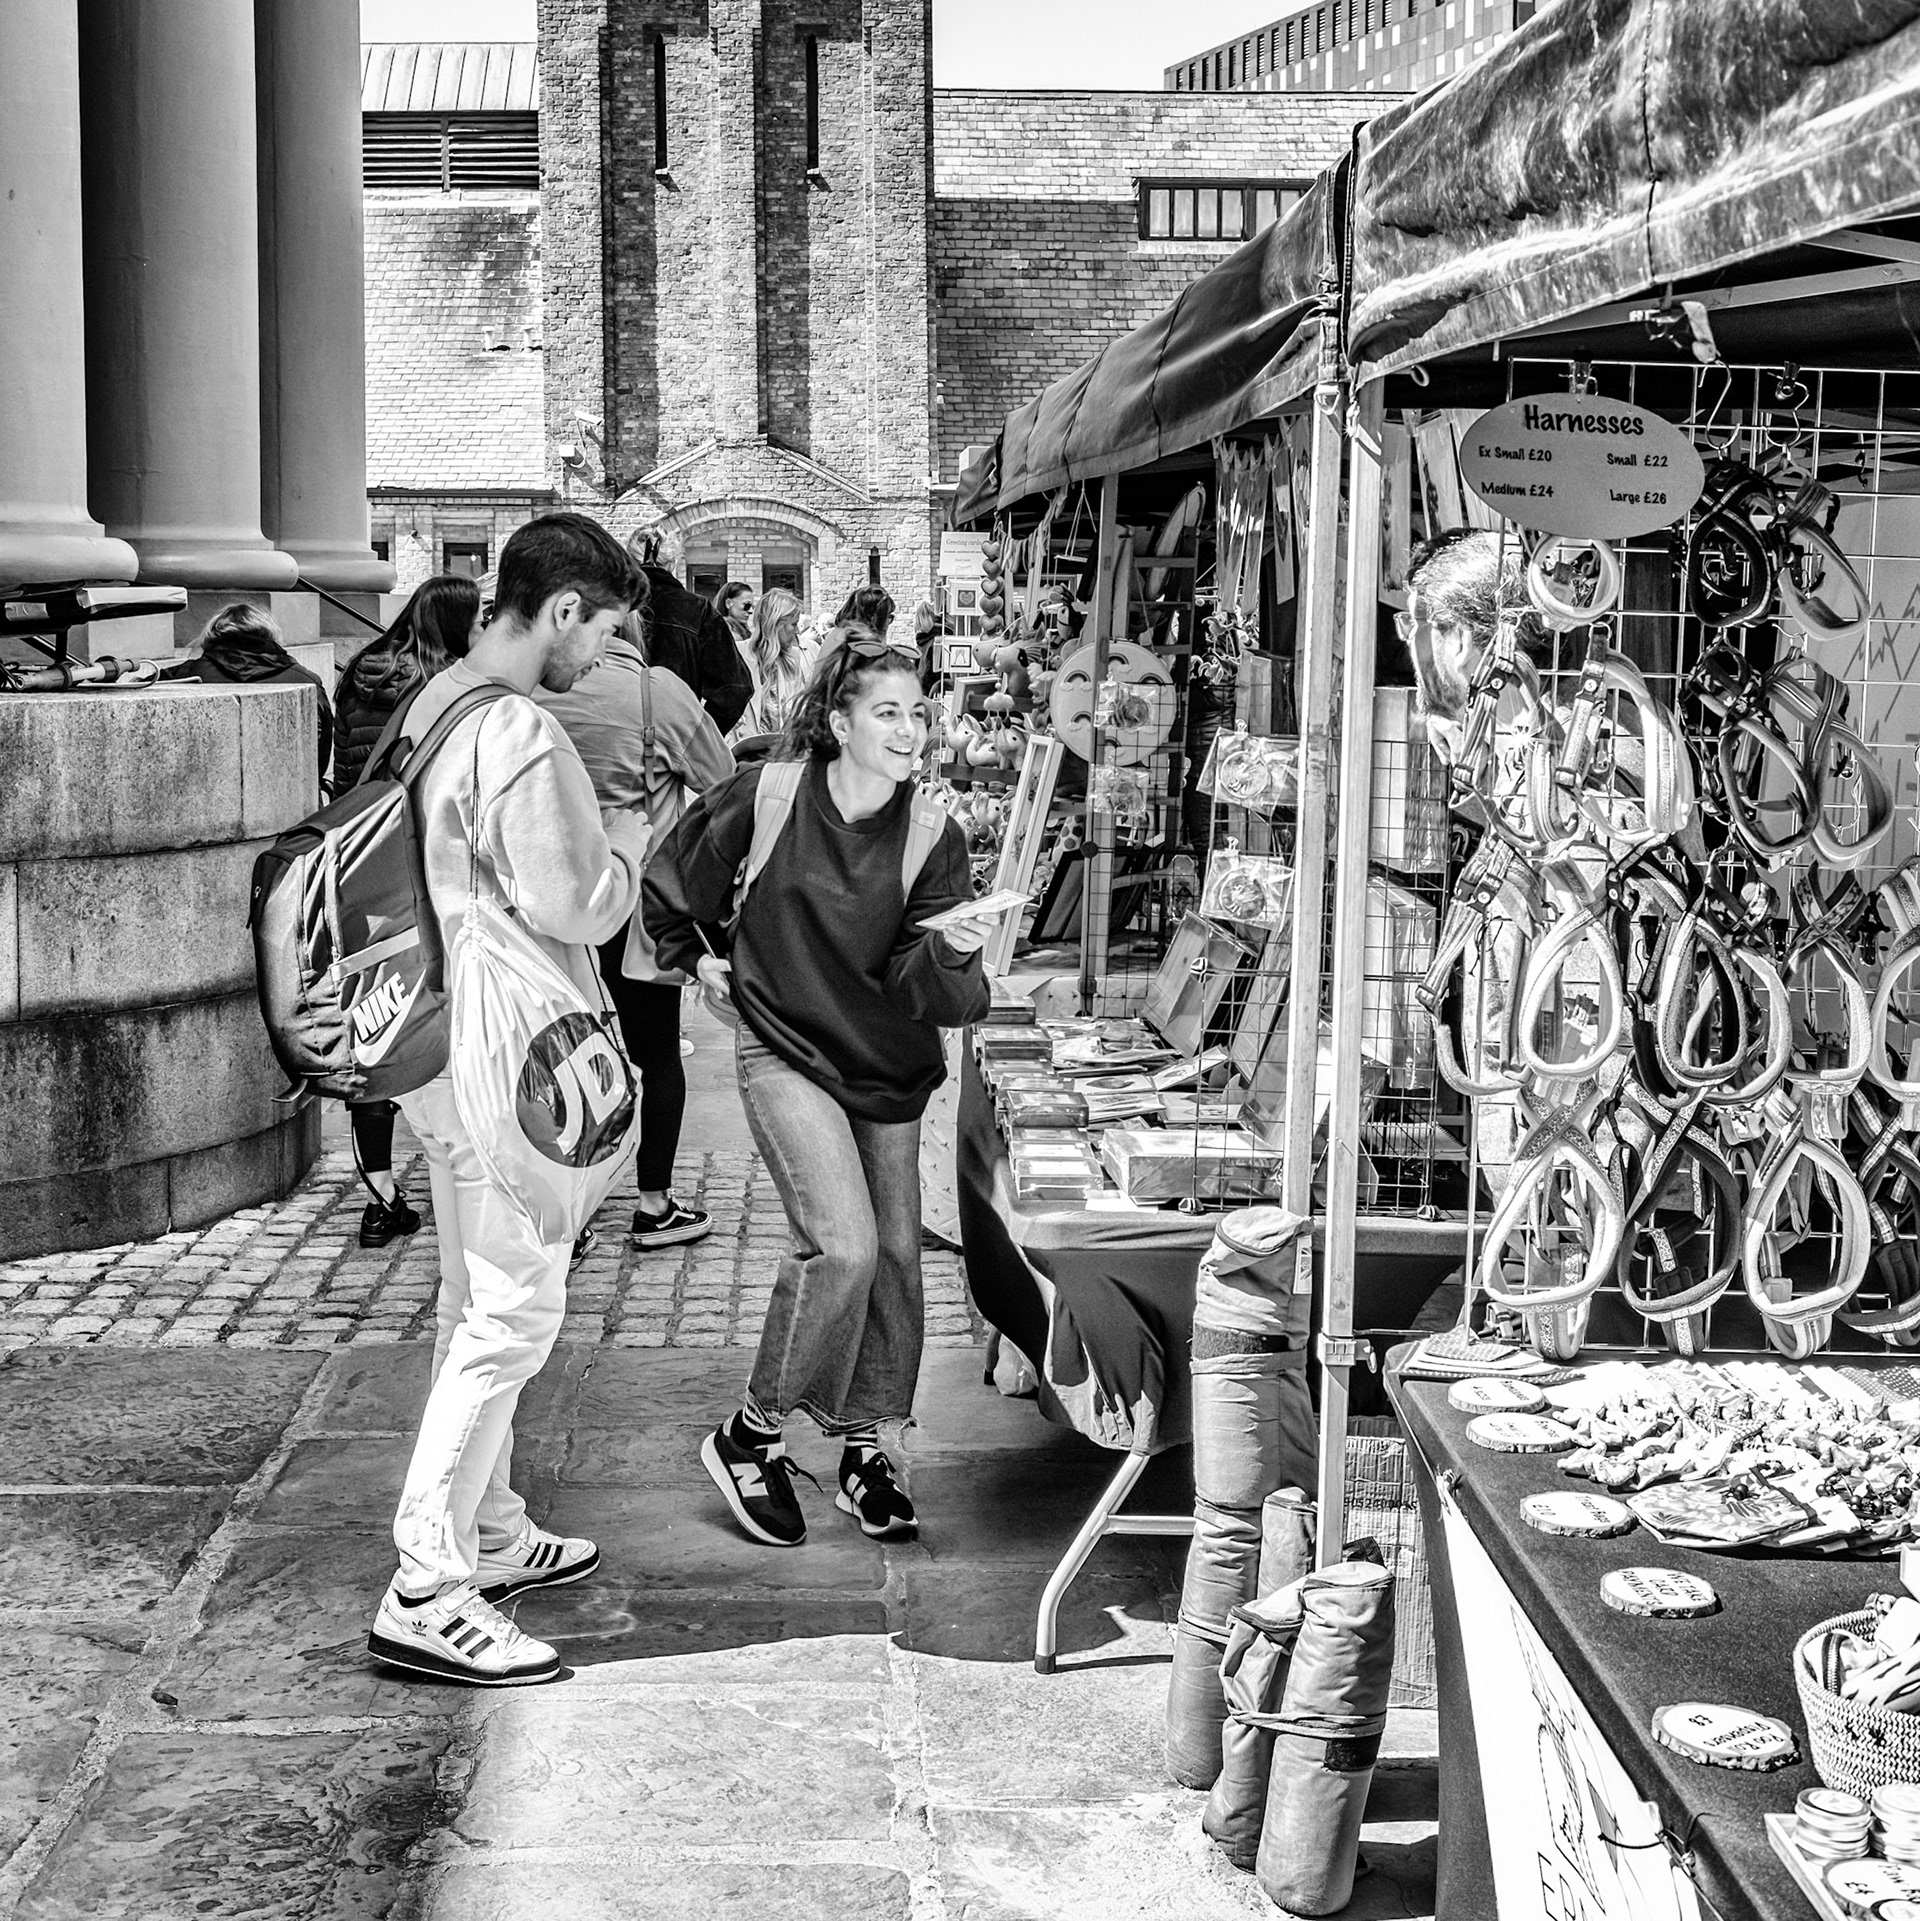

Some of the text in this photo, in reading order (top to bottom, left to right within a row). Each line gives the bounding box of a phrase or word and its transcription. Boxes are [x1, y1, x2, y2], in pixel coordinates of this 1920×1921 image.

[1524, 404, 1644, 435] Harnesses
[1478, 445, 1552, 462] Ex Small £20
[1607, 453, 1668, 467] Small £22
[1481, 482, 1554, 498] Medium £24
[1610, 489, 1667, 505] Large £26
[351, 971, 405, 1042] NIKE
[552, 1031, 627, 1156] JD
[729, 1463, 769, 1498] N
[1649, 1579, 1679, 1596] CARD
[1688, 1714, 1713, 1726] £8
[1753, 1733, 1784, 1744] Poo
